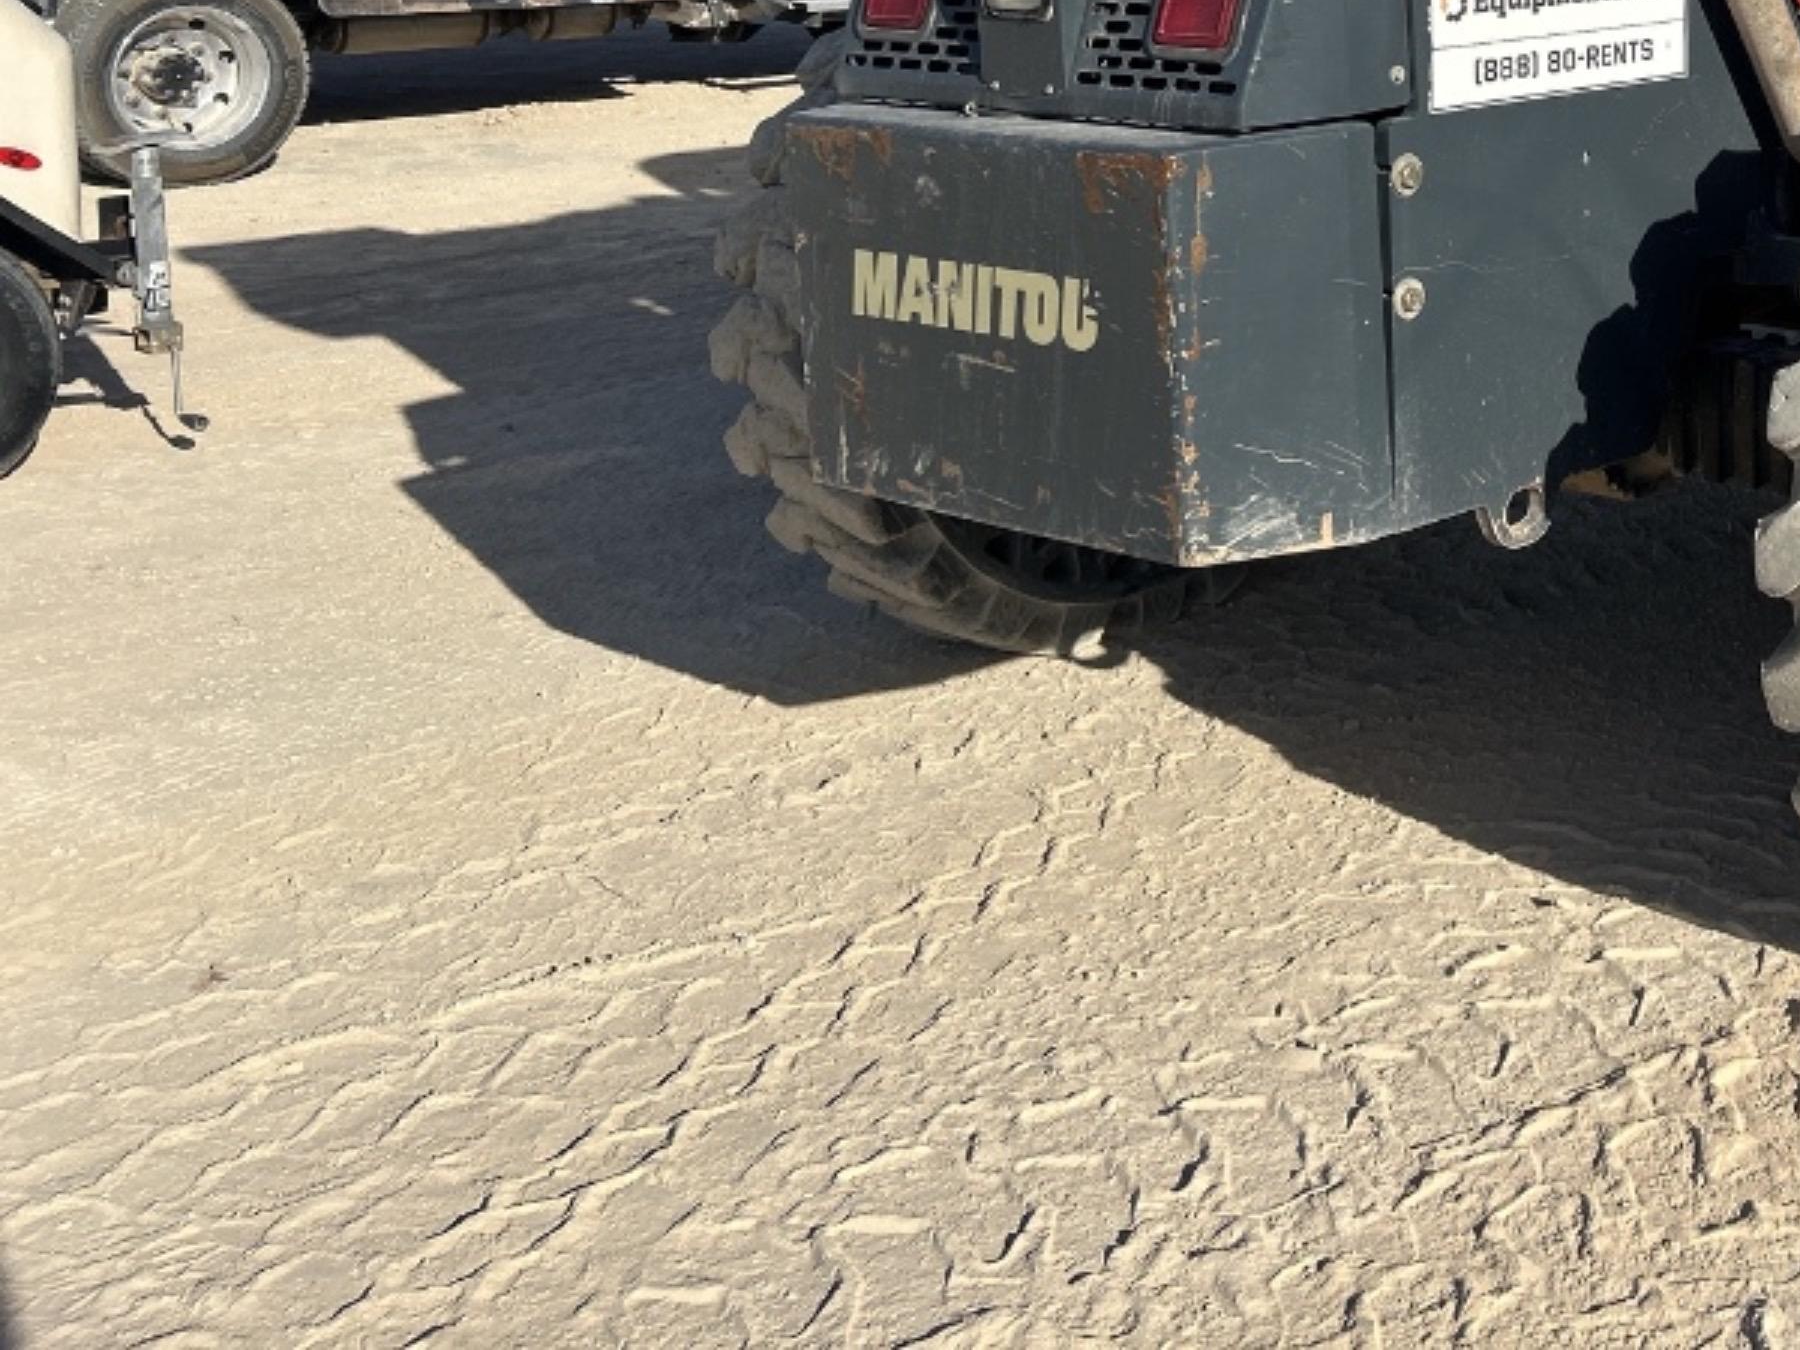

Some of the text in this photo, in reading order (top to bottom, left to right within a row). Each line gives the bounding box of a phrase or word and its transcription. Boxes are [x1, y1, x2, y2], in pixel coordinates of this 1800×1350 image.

[1474, 38, 1655, 85] (888) 80-RENTS
[852, 248, 1099, 352] MANITOU
